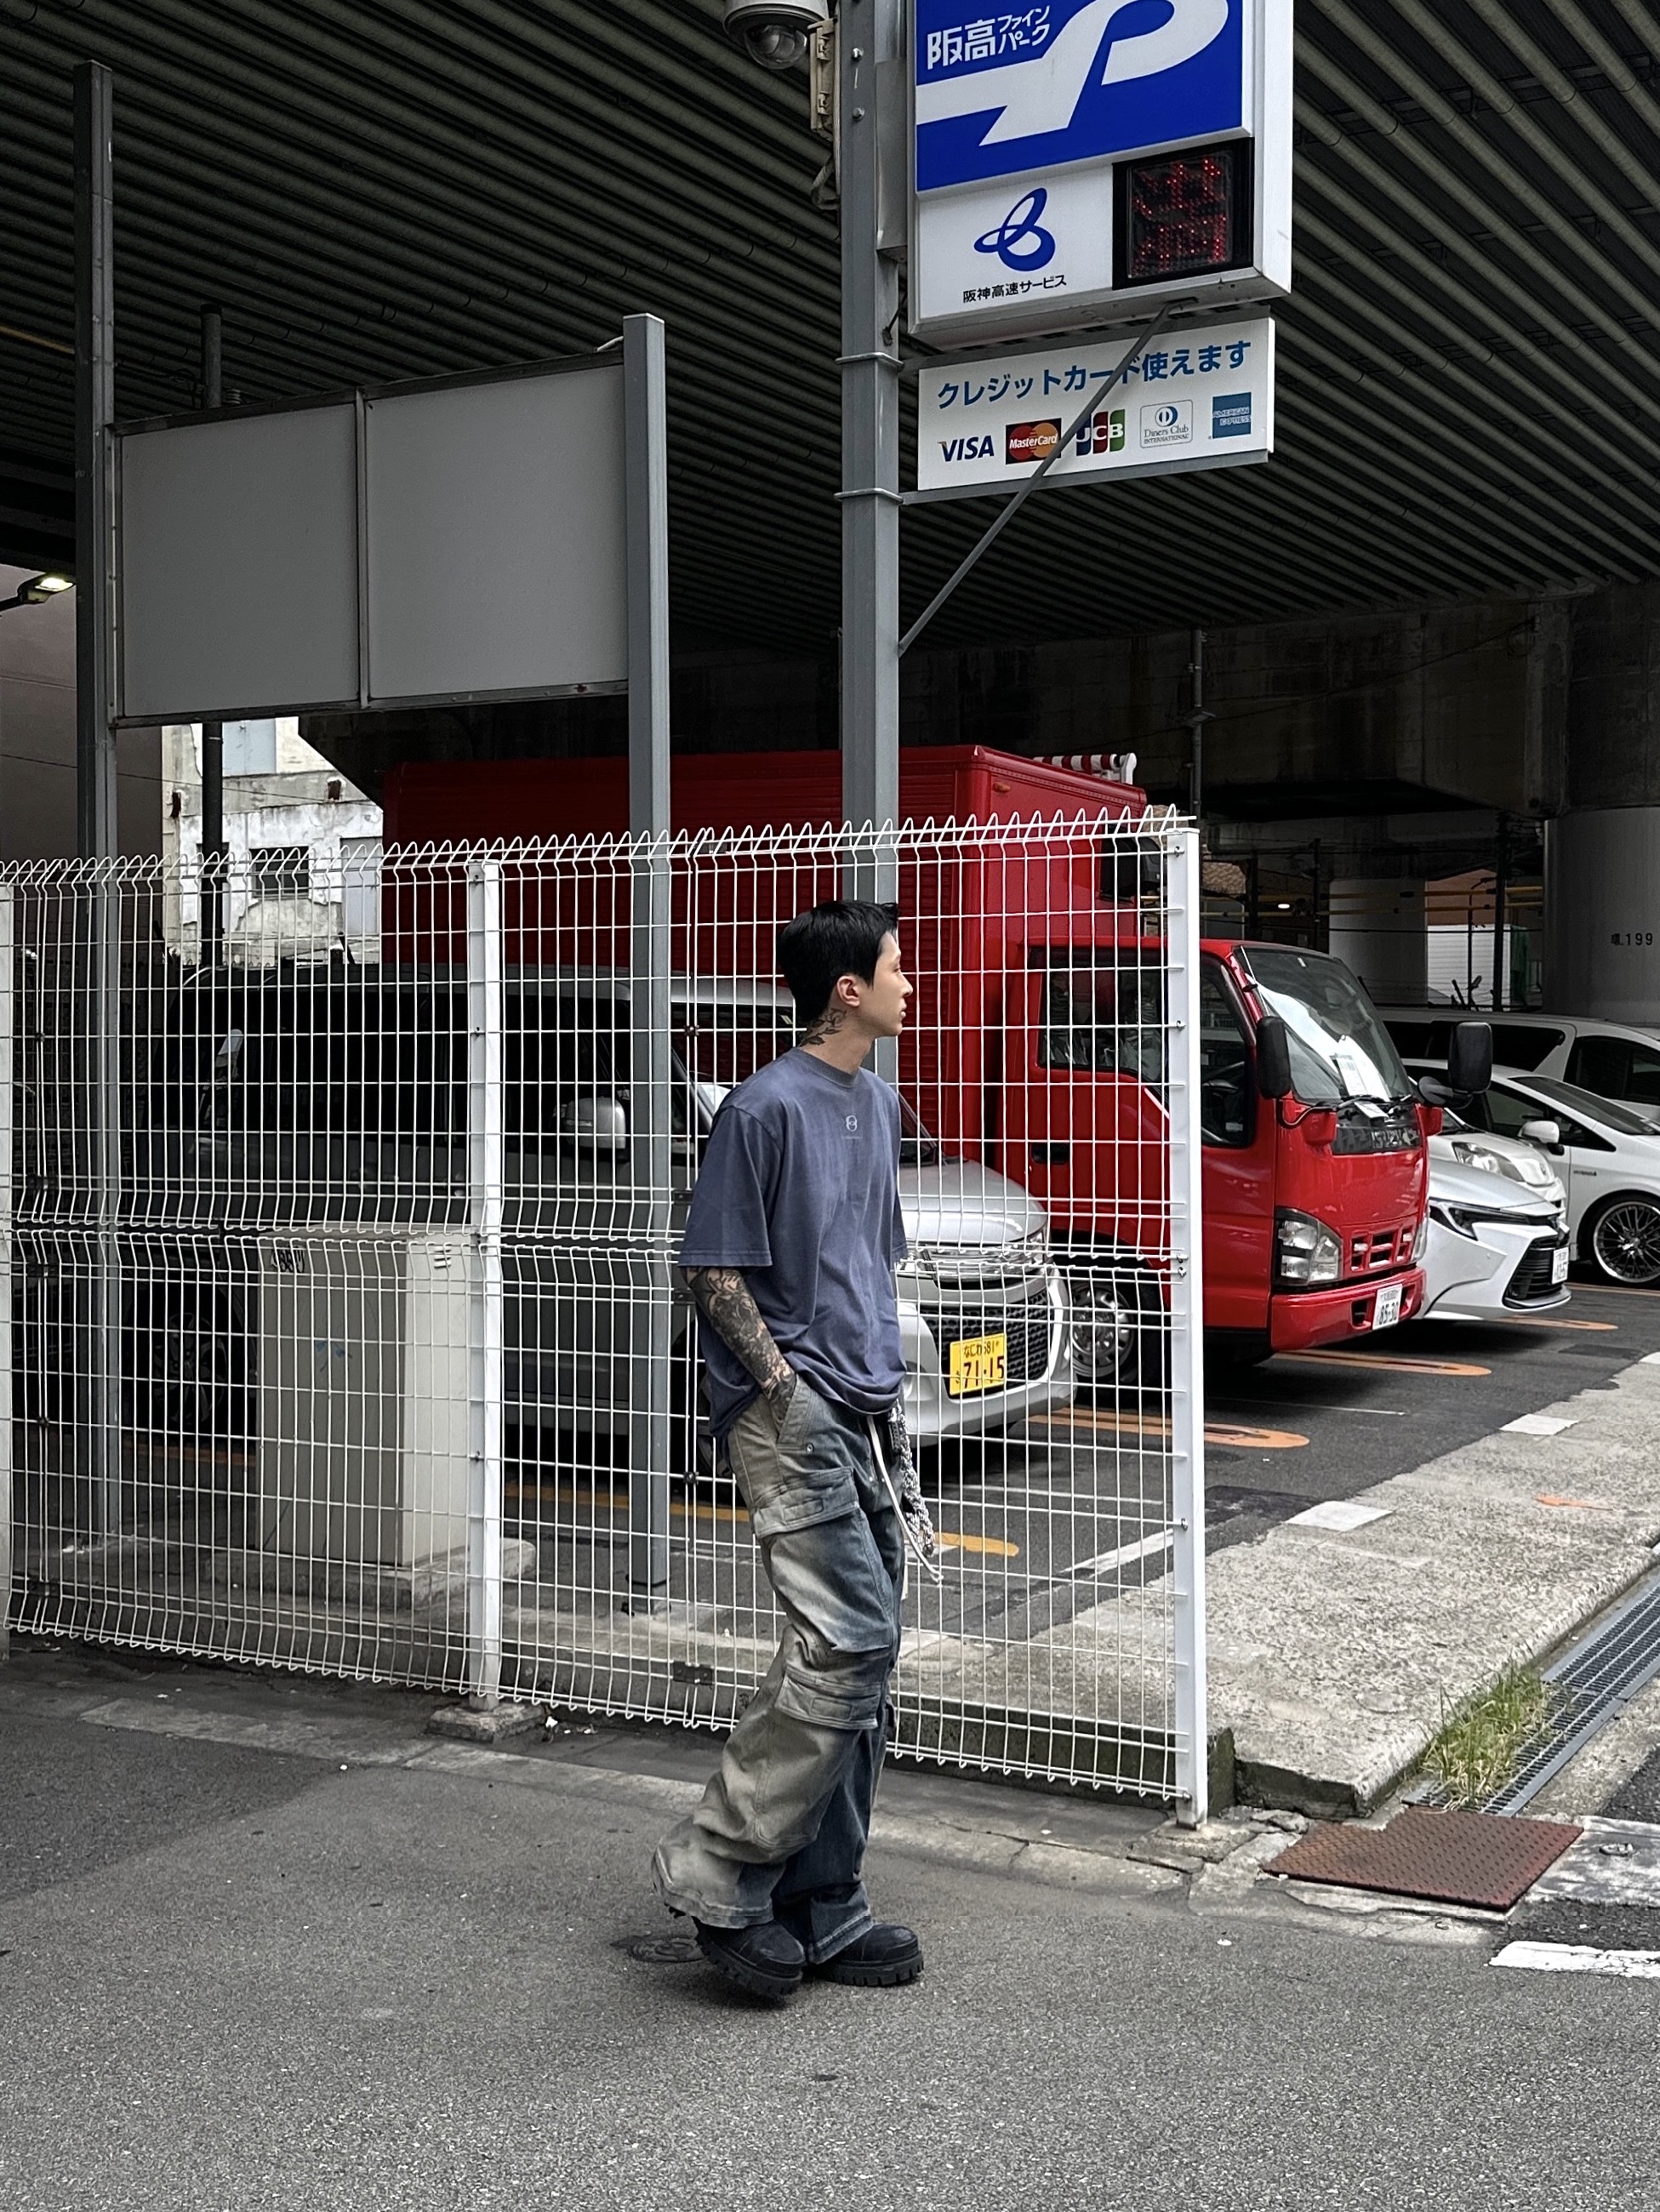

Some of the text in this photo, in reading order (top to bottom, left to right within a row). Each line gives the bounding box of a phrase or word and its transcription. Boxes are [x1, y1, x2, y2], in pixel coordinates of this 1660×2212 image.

[997, 5, 1050, 33] ファイン
[927, 19, 995, 70] 阪高
[998, 24, 1050, 54] パーク
[963, 274, 1067, 303] 阪神高速サービス
[938, 340, 1252, 409] クレジットカード使えます
[1009, 434, 1058, 450] MasterCard
[1075, 422, 1124, 442] JCB
[1144, 424, 1189, 437] Diners Club
[938, 435, 995, 462] VISA
